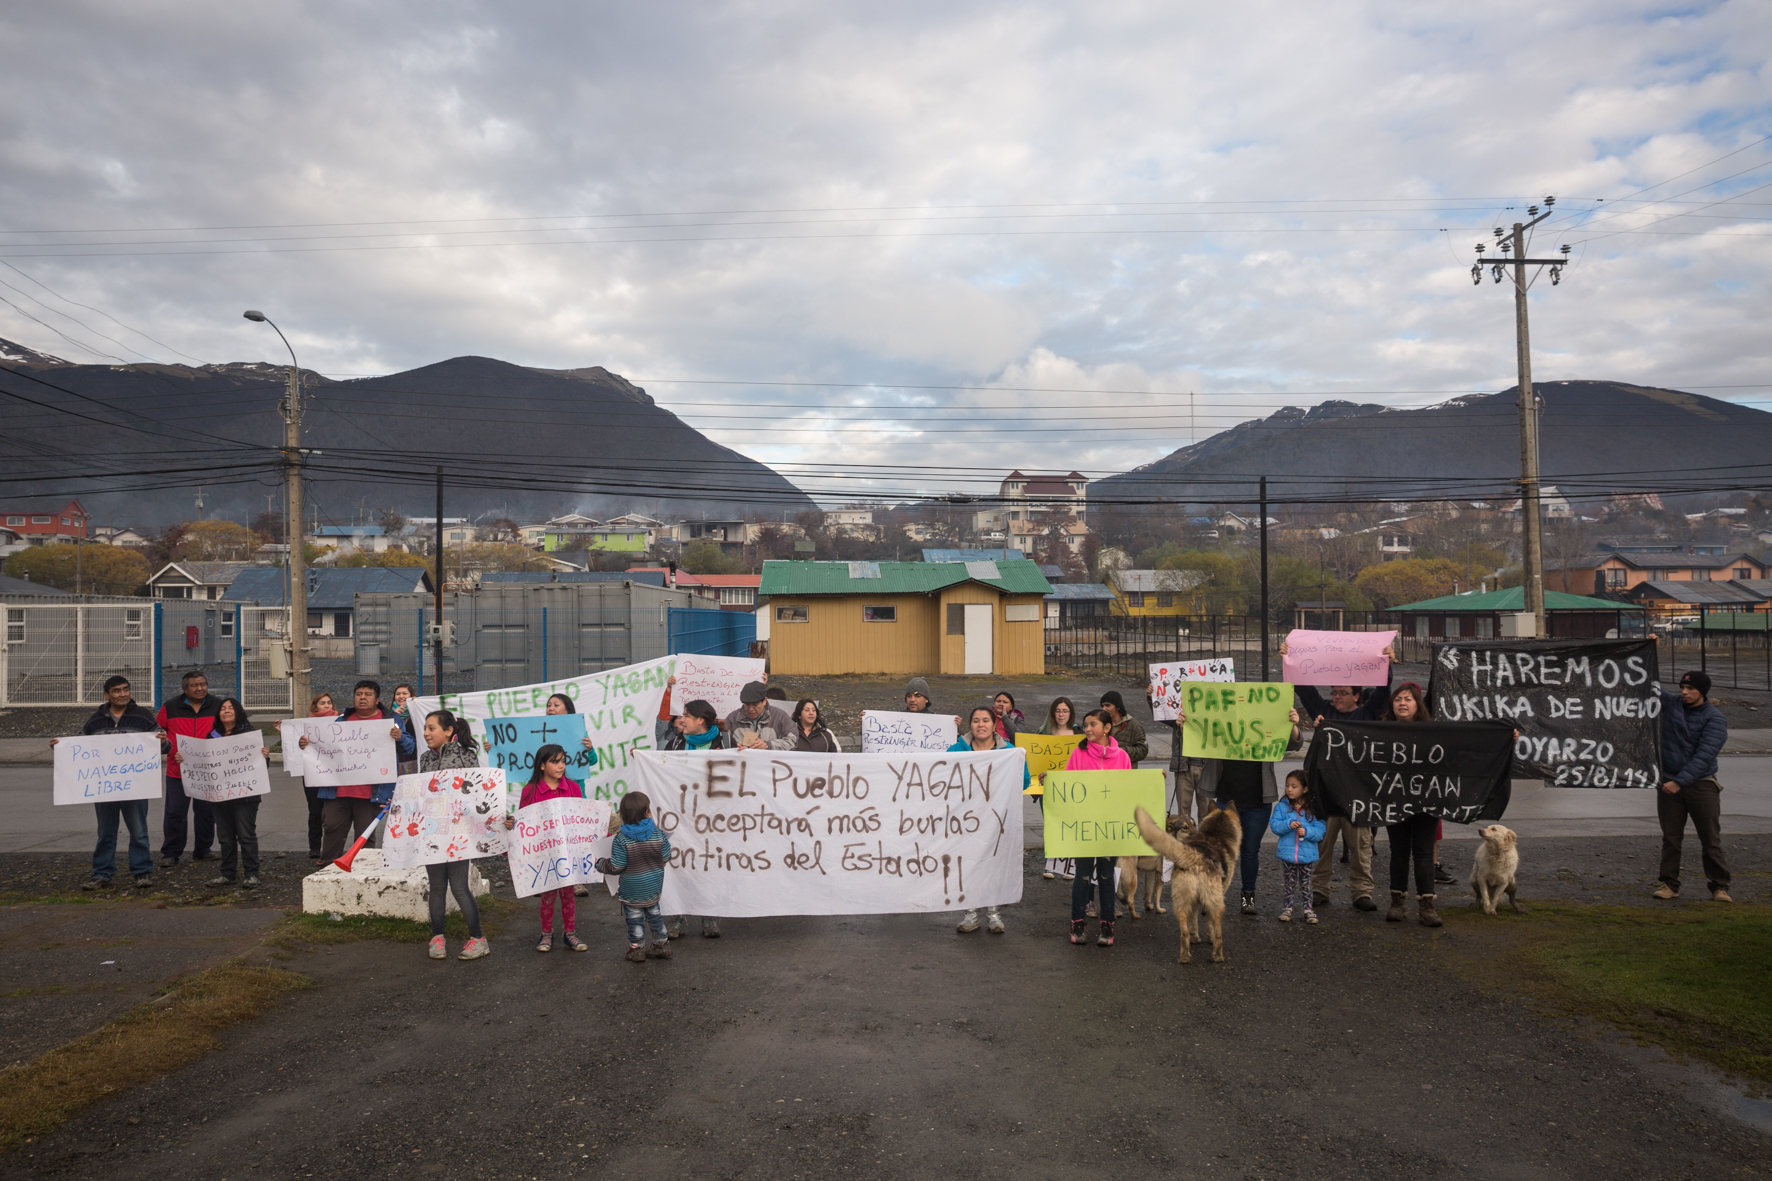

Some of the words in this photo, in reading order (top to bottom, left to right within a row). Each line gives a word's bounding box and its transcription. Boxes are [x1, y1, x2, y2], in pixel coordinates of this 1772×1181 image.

[595, 660, 676, 705] YAGAN
[1440, 694, 1534, 721] UKIKA
[1549, 695, 1584, 719] DE
[306, 726, 325, 744] El
[327, 723, 370, 743] Pueblo
[491, 722, 518, 746] NO
[530, 721, 558, 743] +
[1323, 727, 1444, 764] PUEBLO
[114, 744, 144, 755] UNA
[1030, 742, 1075, 756] BAST
[1515, 735, 1614, 765] OYARZO
[1047, 760, 1066, 770] DE
[770, 759, 869, 799] Pueblo
[886, 760, 992, 802] YAGAN
[1052, 781, 1087, 803] NO
[1100, 785, 1111, 799] +
[1371, 772, 1461, 798] YAGAN
[694, 804, 822, 842] aceptará
[827, 806, 881, 835] más
[898, 804, 980, 839] burlas
[668, 837, 771, 873] entiras
[783, 840, 827, 875] del
